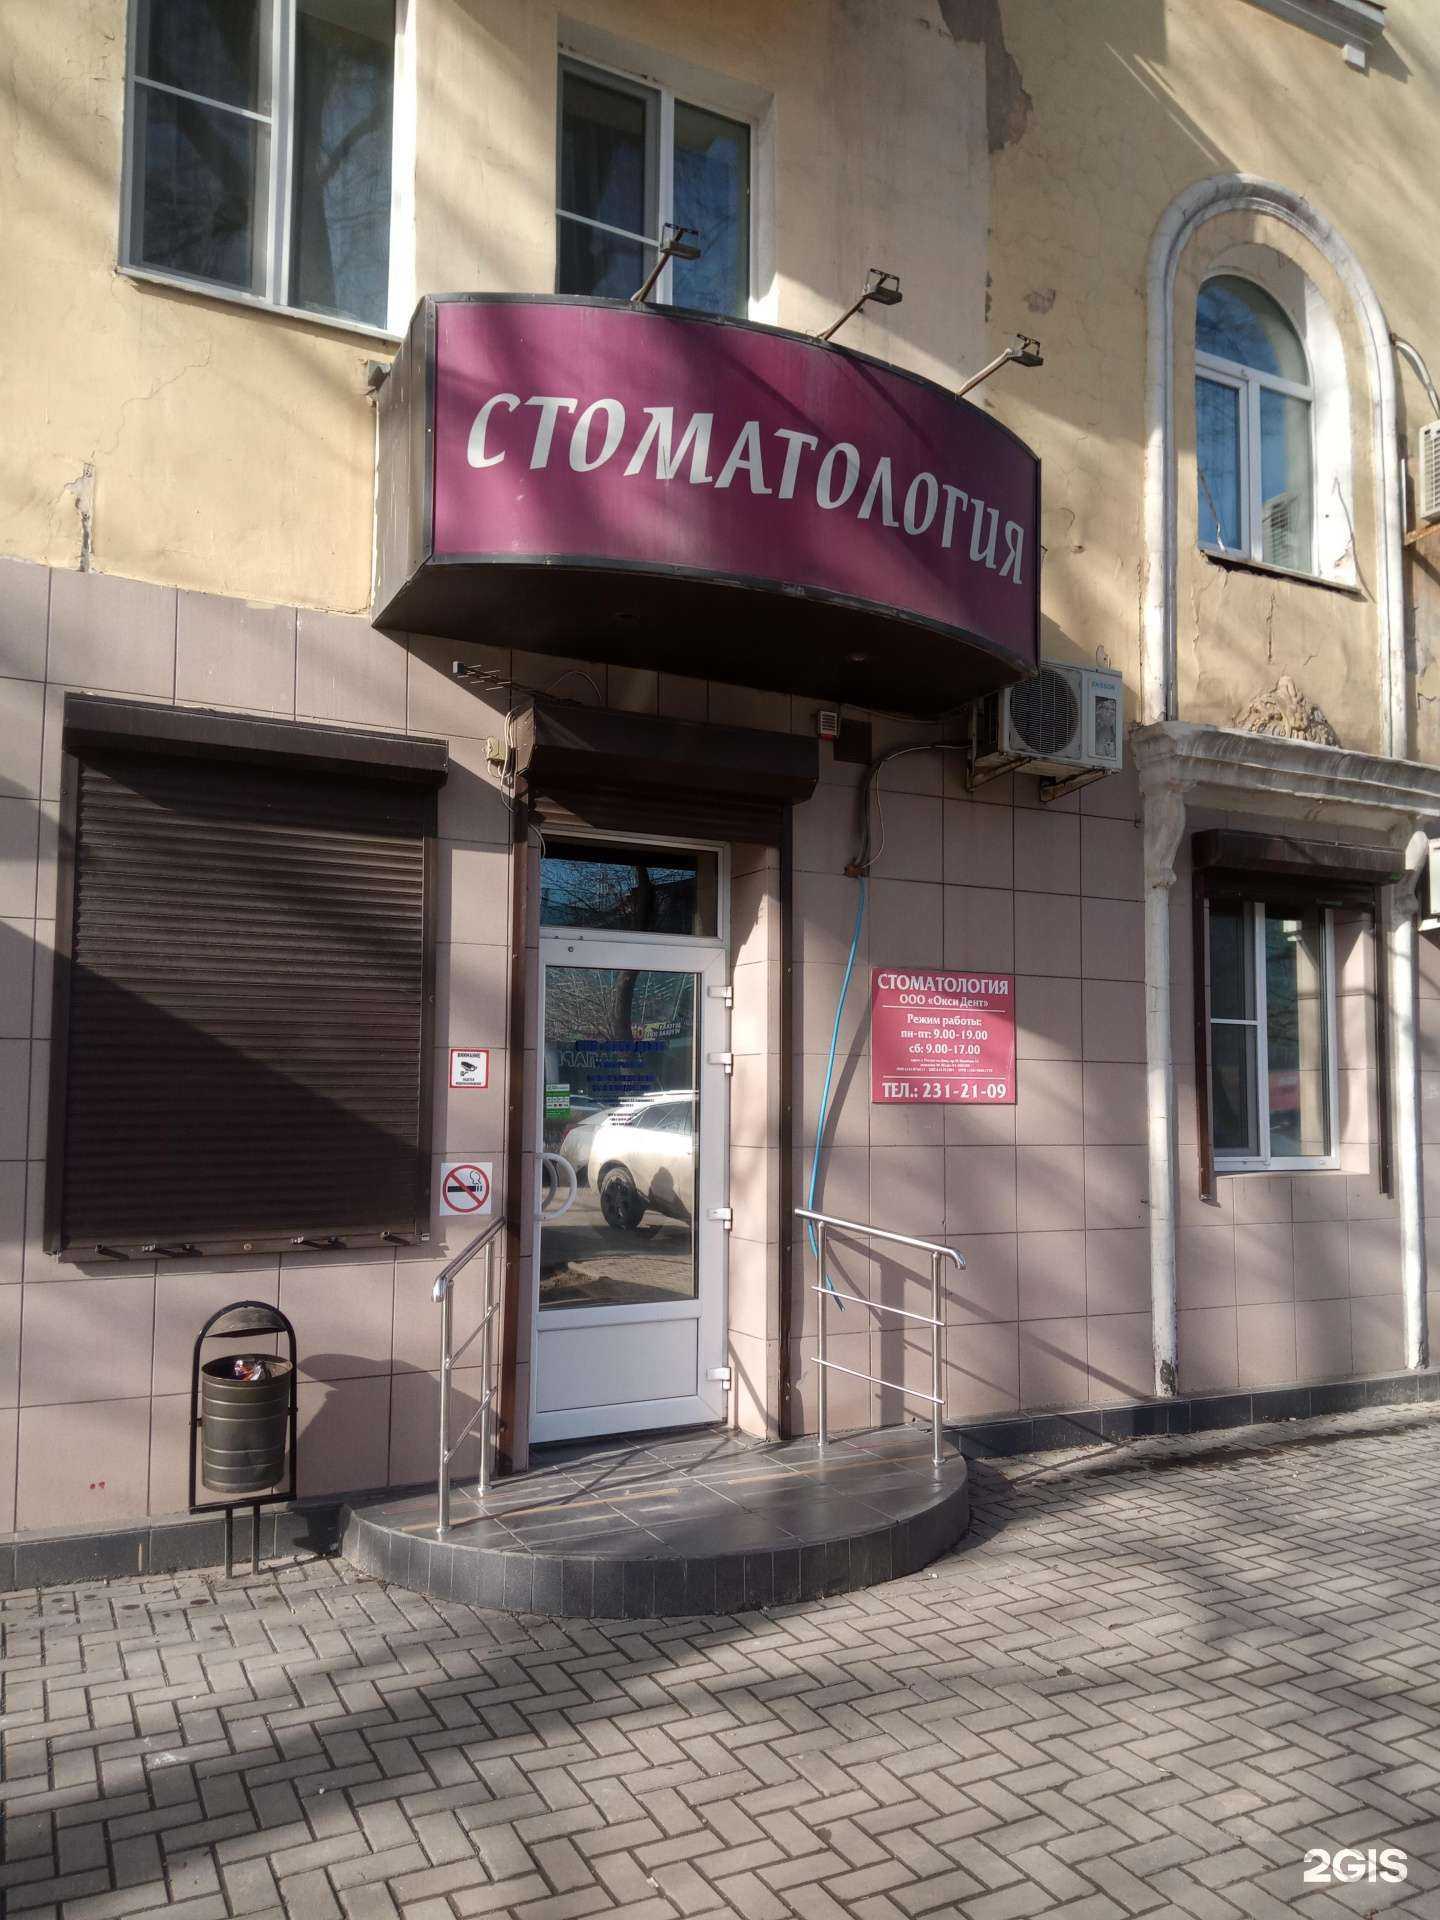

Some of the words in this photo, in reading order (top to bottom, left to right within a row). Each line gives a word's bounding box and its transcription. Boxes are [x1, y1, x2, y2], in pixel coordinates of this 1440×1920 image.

[467, 392, 1025, 585] СТОМАТОЛОГИЯ
[877, 973, 1009, 995] СТОМАТОЛОГИЯ
[899, 994, 926, 1005] ООО
[907, 1013, 941, 1025] Режим
[942, 1015, 982, 1027] работы:
[900, 1030, 932, 1039] пн-пт:
[933, 1029, 988, 1041] 9.00-19.00
[908, 1043, 924, 1054] сб:
[925, 1044, 981, 1055] 9.00-17.00
[882, 1082, 919, 1098] ТЕЛ.:
[922, 1082, 1007, 1099] 231-21-09
